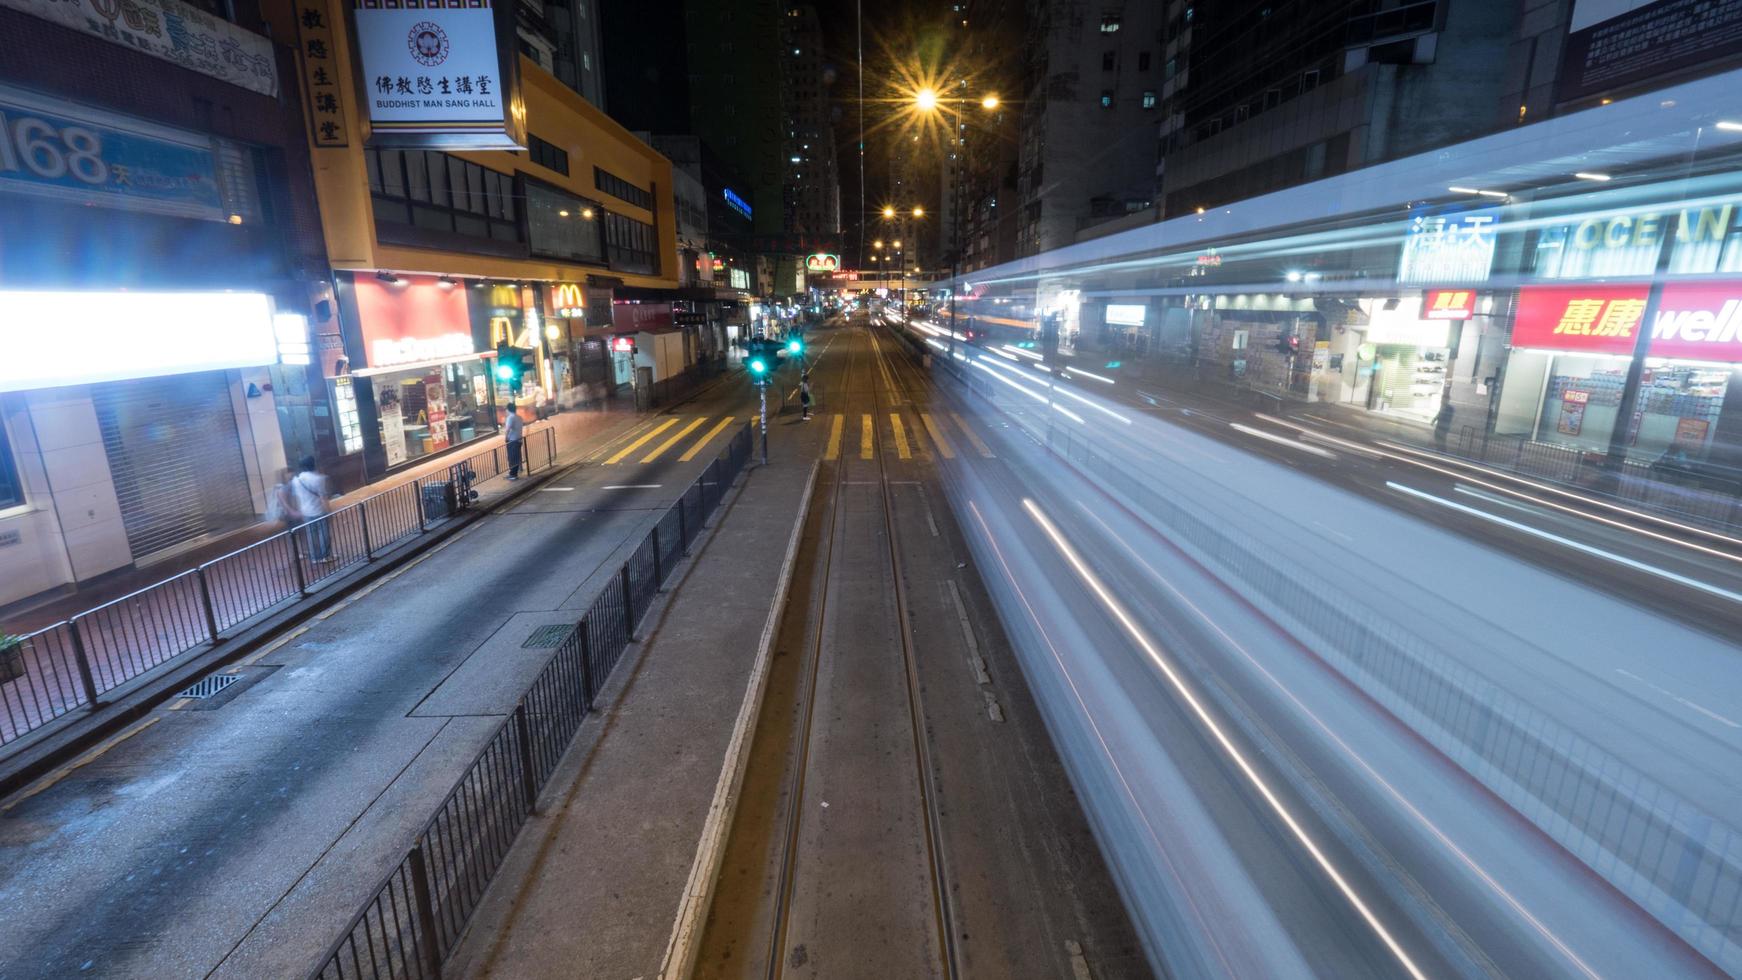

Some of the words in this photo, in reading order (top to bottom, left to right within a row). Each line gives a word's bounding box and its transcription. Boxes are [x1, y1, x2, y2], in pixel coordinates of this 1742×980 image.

[376, 100, 421, 108] BUDDHIST
[423, 100, 443, 108] MAN
[445, 100, 470, 108] SANG
[472, 100, 496, 108] HALL
[1575, 204, 1733, 250] OCEAN
[1553, 299, 1647, 337] 惠康
